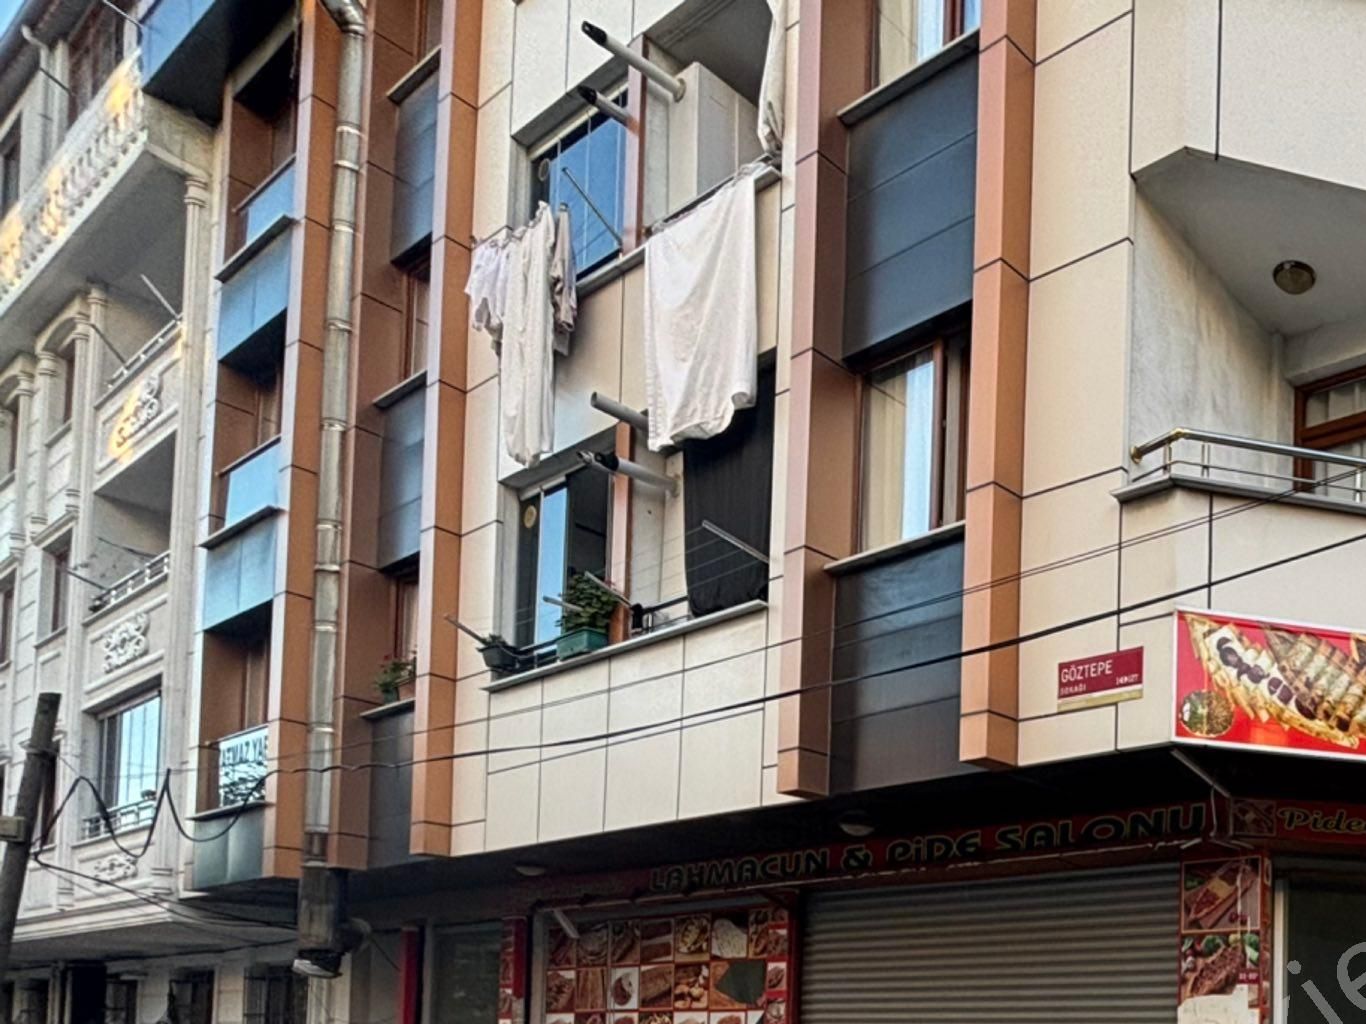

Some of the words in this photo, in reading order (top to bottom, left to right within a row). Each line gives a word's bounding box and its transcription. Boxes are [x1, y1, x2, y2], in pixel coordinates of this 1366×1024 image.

[1061, 660, 1113, 683] GÖZTEPE
[649, 847, 831, 892] LAHMACUN
[841, 843, 873, 872] &
[994, 802, 1207, 852] SALONU
